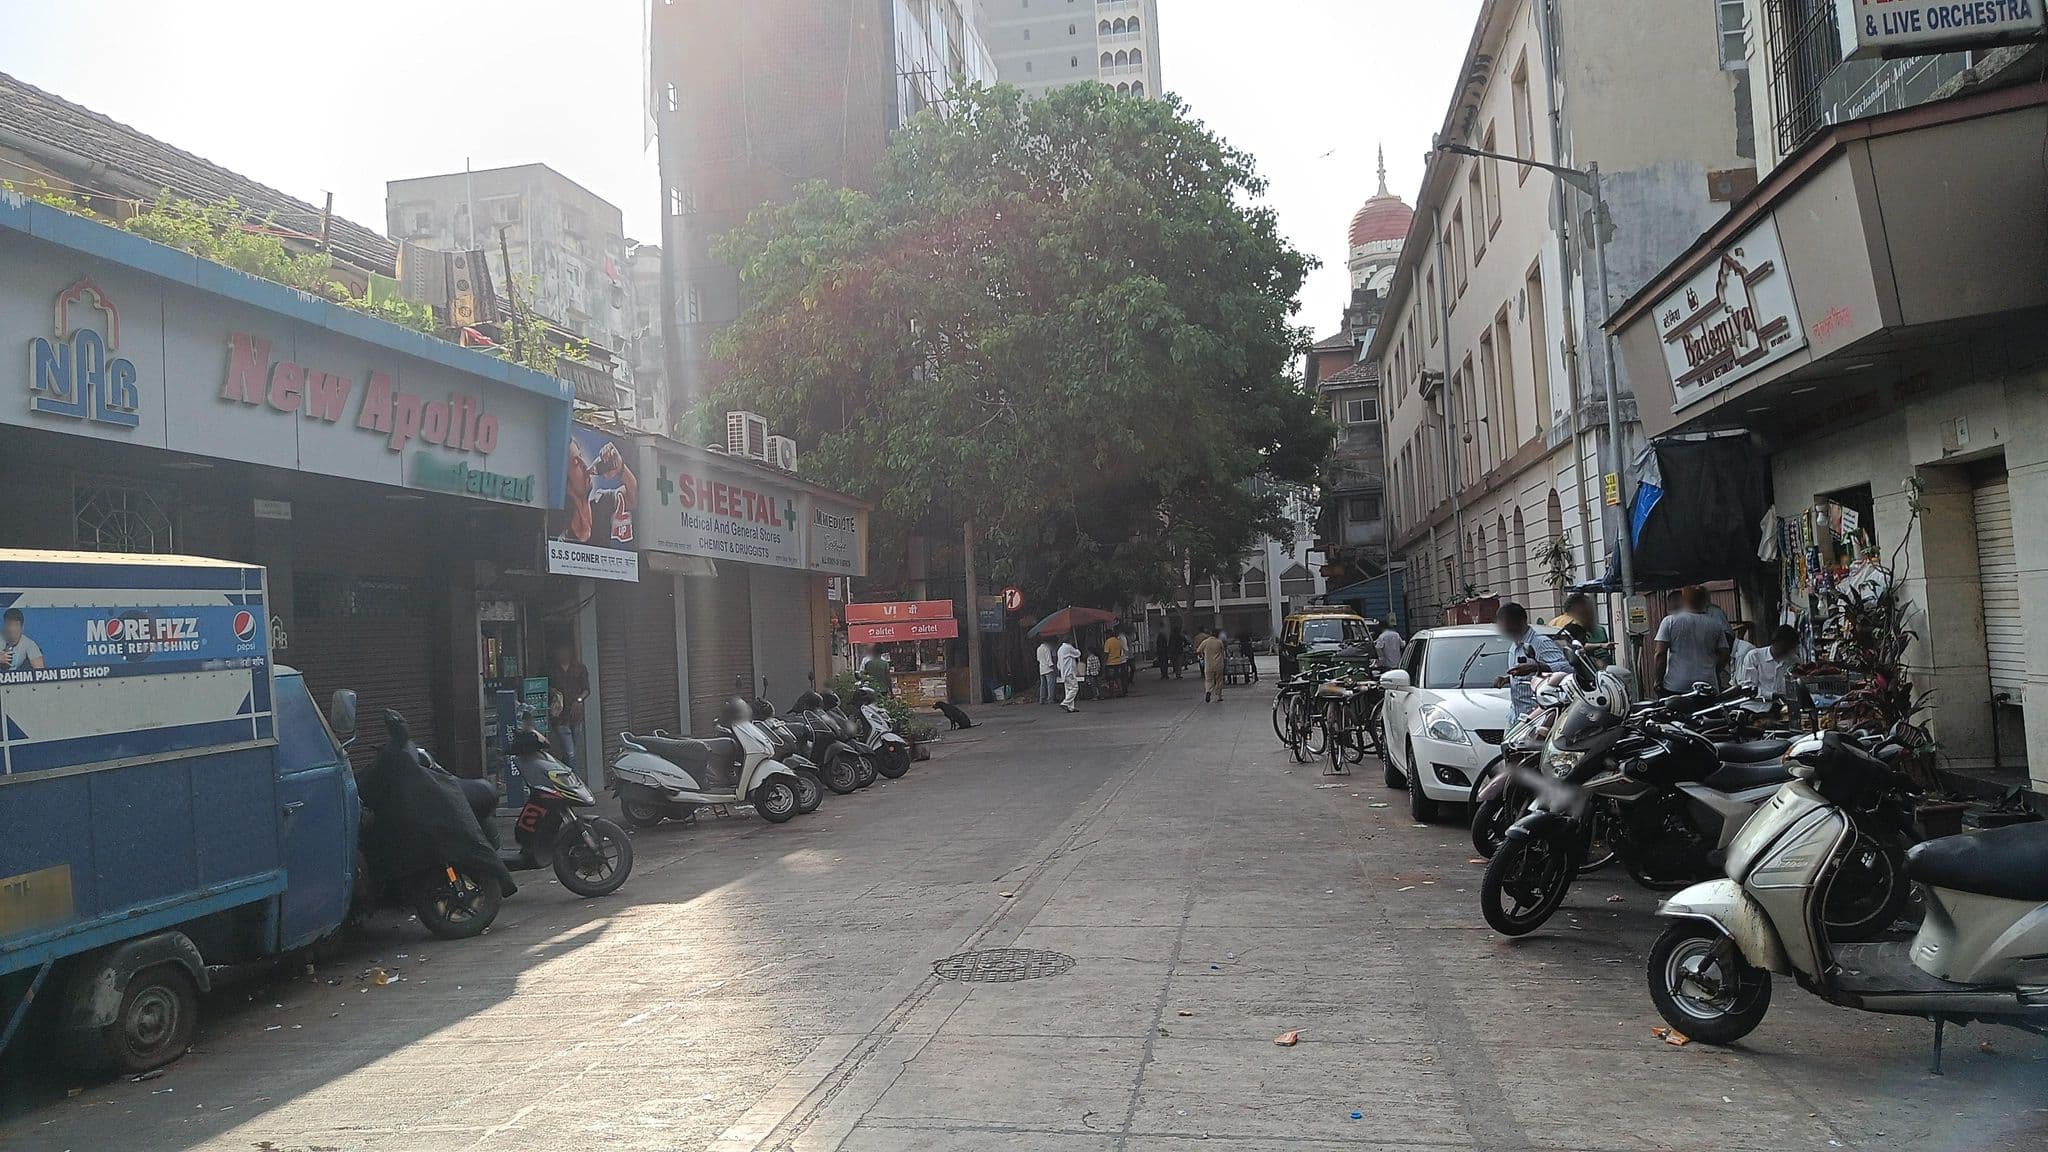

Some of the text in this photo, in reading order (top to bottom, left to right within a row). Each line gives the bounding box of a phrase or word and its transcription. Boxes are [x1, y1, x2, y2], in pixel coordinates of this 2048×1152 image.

[1866, 0, 2032, 36] & LIVE ORCHESTRA
[1682, 303, 1755, 370] Bademiya
[219, 332, 500, 454] New Apollo
[414, 450, 535, 502] taurant
[679, 472, 782, 528] SHEETAL
[681, 511, 781, 544] Medical And General Stores
[571, 551, 600, 564] CORNER
[699, 538, 728, 552] CHEMIST
[730, 543, 734, 553] &
[735, 544, 769, 558] DRUGGISTS
[87, 617, 198, 642] MORE FIZZ
[875, 627, 895, 636] airtel
[918, 624, 938, 633] airtel
[87, 640, 199, 656] MORE REFRESHING
[237, 644, 255, 652] pepsi
[35, 670, 58, 681] PAN
[60, 668, 81, 679] BIDI
[83, 666, 110, 678] SHOP
